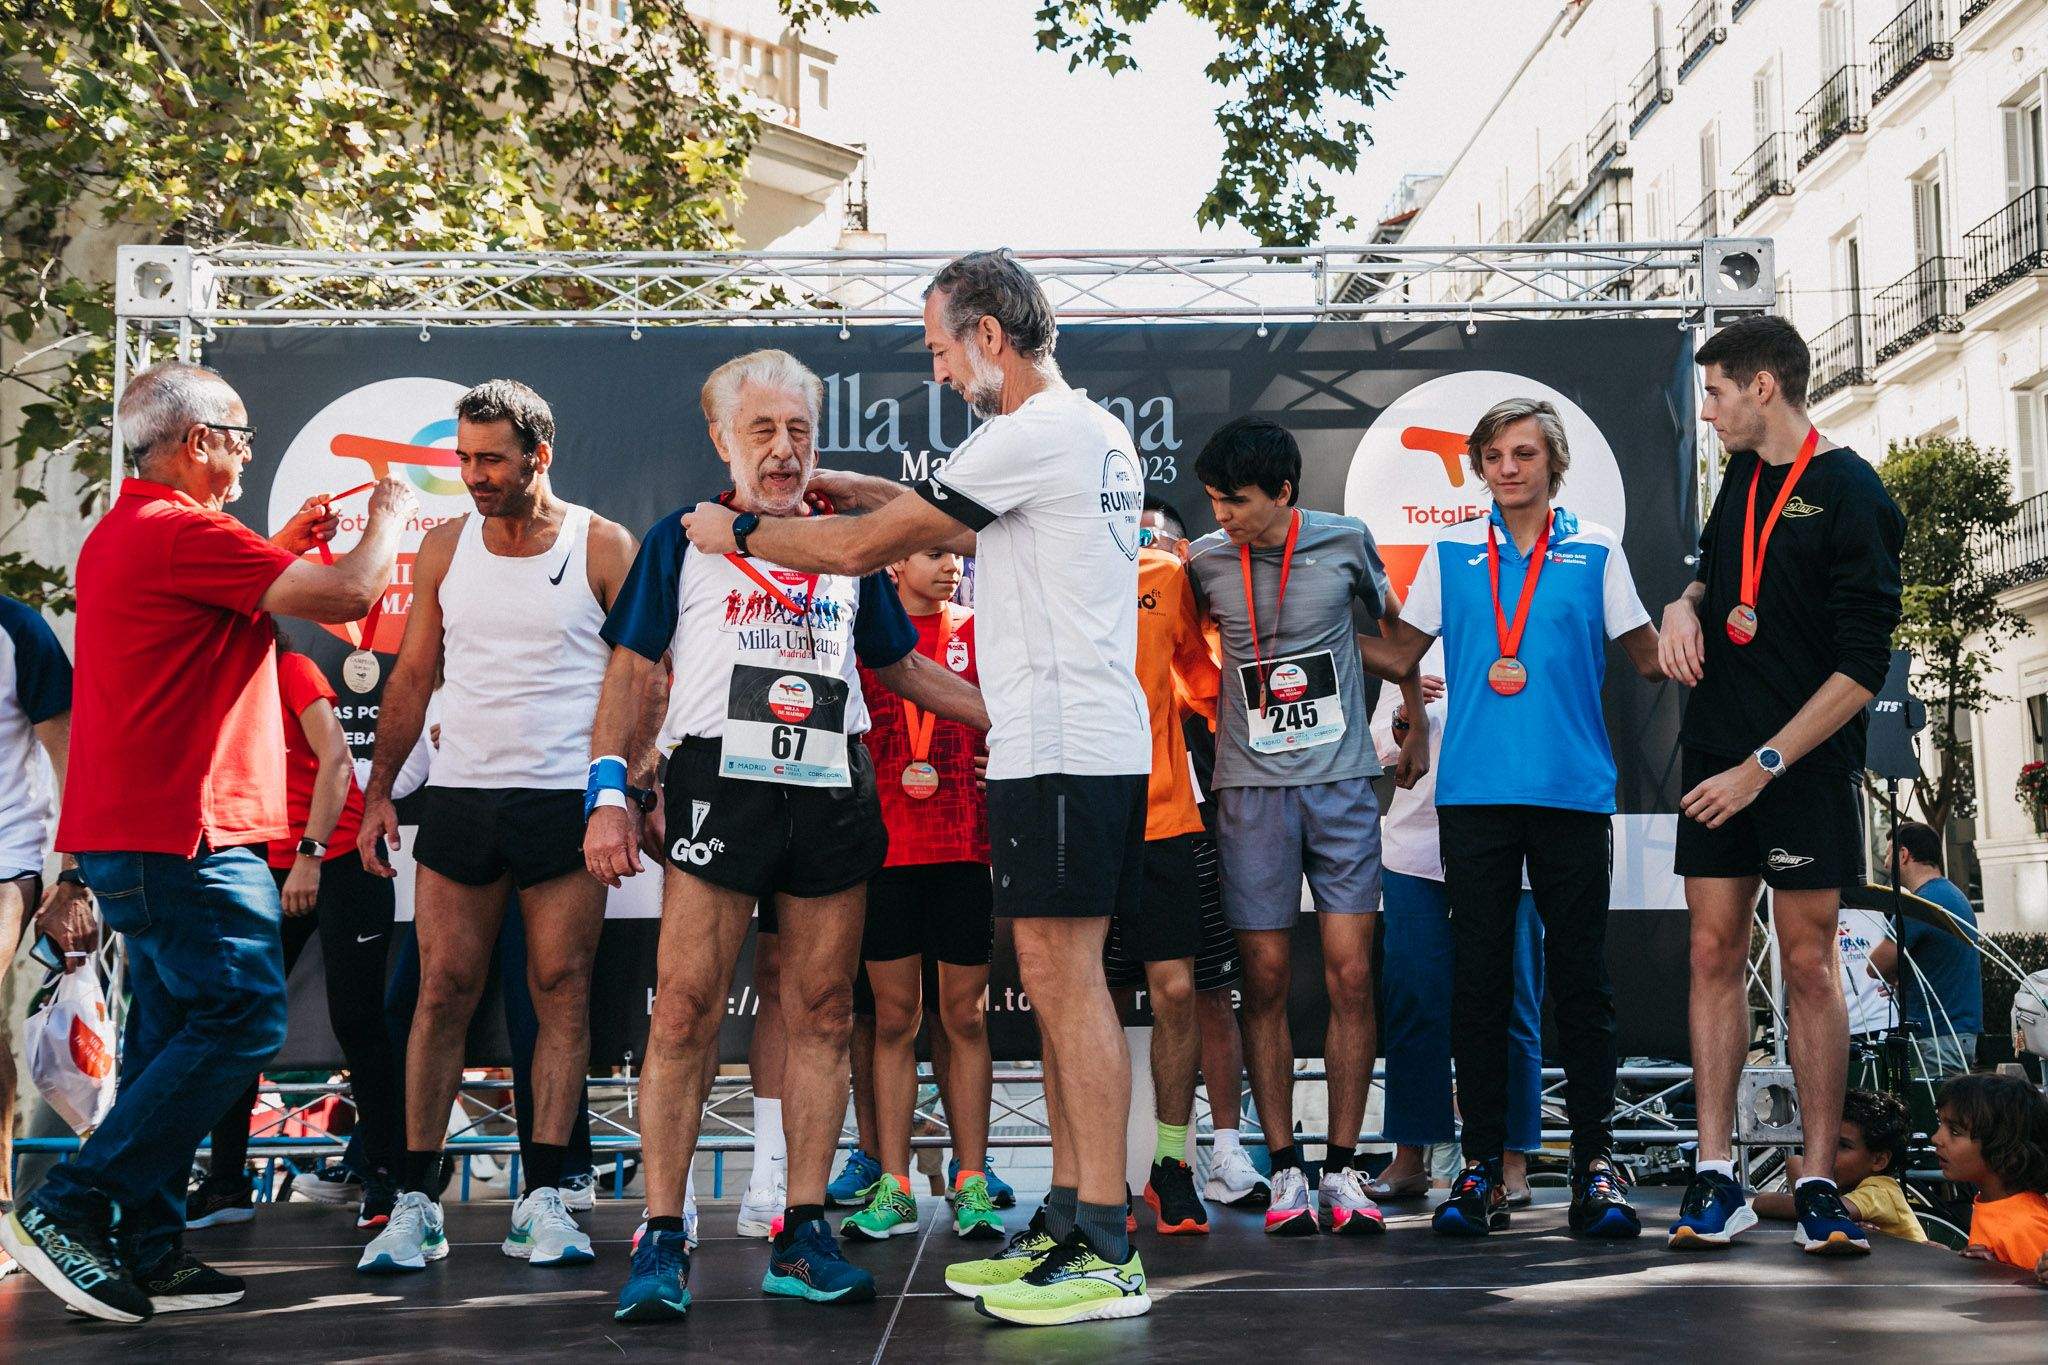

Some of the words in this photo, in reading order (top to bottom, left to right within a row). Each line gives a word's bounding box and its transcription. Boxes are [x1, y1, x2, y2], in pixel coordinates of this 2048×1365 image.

[738, 628, 781, 650] Milla
[778, 649, 807, 659] Madrid
[1268, 701, 1319, 734] 245
[771, 725, 808, 761] 67
[671, 838, 713, 866] GO
